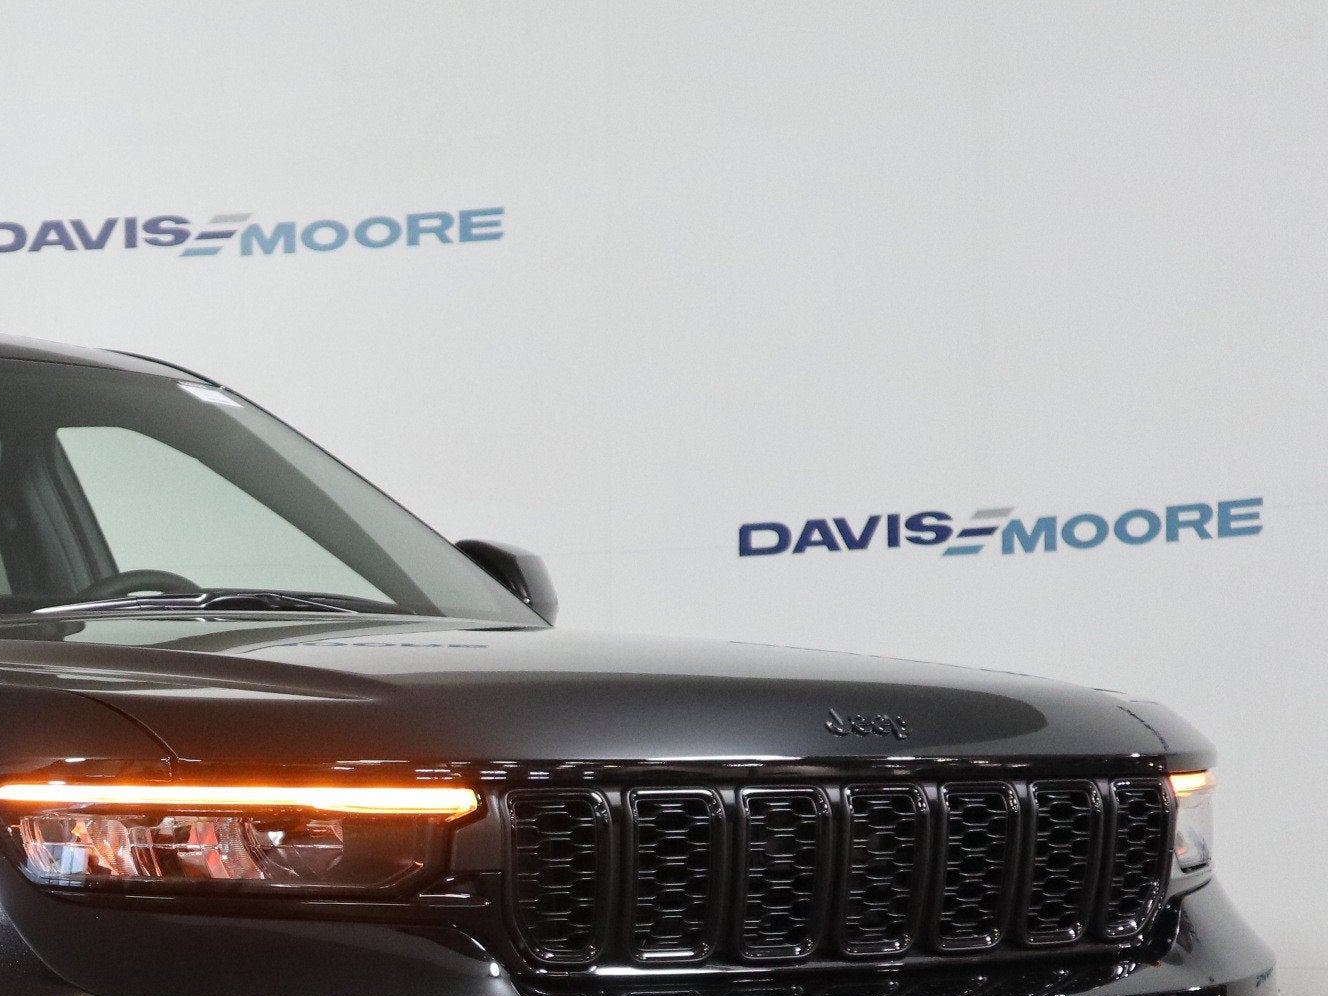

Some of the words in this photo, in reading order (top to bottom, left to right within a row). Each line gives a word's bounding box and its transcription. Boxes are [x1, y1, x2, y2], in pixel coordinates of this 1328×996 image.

[240, 207, 505, 257] MOORE
[738, 511, 954, 558] DAVIS
[1000, 495, 1265, 557] MOORE
[824, 707, 910, 740] Jeep
